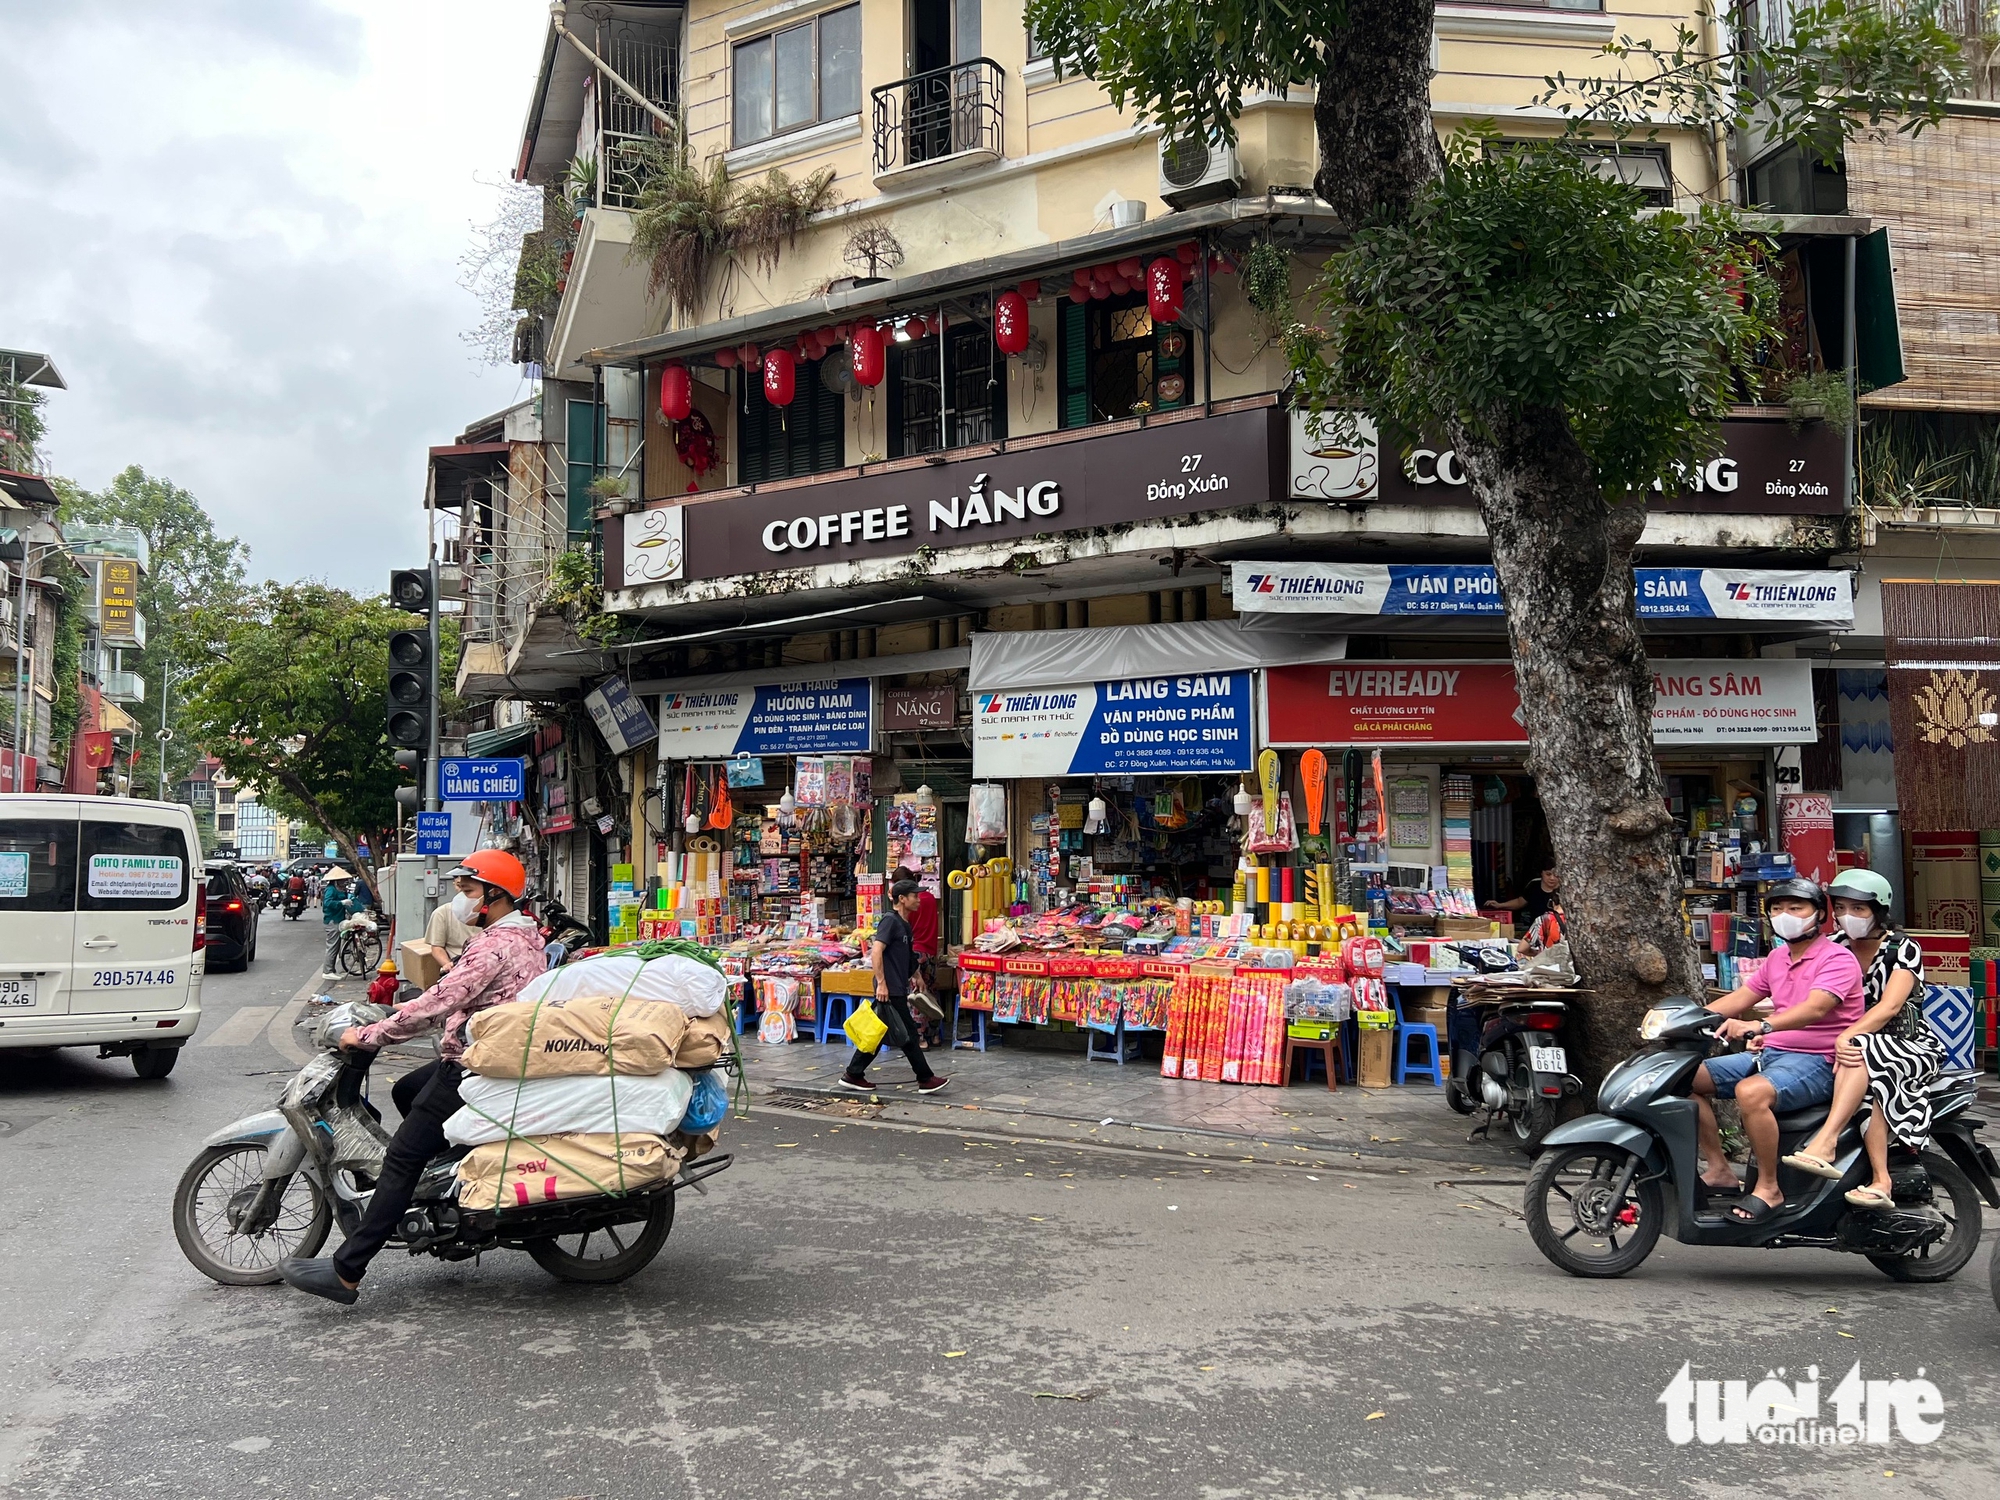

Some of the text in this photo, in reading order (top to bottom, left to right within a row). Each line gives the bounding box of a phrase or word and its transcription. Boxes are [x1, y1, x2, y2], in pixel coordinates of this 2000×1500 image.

[1180, 453, 1203, 473] 27
[1788, 458, 1805, 473] 27
[1146, 473, 1229, 501] Đồng Xuân
[1765, 480, 1829, 498] Đồng Xuân
[762, 473, 1060, 552] COFFEE NẮNG
[1406, 574, 1448, 594] VĂN
[1644, 575, 1688, 598] SÂM
[1430, 602, 1439, 610] 27
[1640, 604, 1690, 613] 0912.936.434
[1176, 673, 1231, 698] SÂM
[1328, 669, 1460, 697] EVEREADY
[1708, 671, 1763, 697] SÂM
[685, 692, 739, 709] THIÊN LONG
[767, 693, 852, 711] HƯƠNG NAM
[895, 696, 942, 717] NẮNG
[1005, 692, 1077, 712] THIÊN LONG
[753, 713, 763, 723] ĐỒ
[764, 713, 785, 723] DÙNG
[786, 714, 801, 723] HỌC
[802, 713, 820, 721] SINH
[848, 709, 867, 719] DÍNH
[981, 715, 999, 725] SỨC
[1032, 714, 1047, 722] TRI
[1049, 711, 1075, 721] THỨC
[1103, 702, 1235, 724] VĂN PHÒNG PHẨM
[1350, 704, 1435, 716] CHẤT LƯỢNG UY TÍN
[1666, 706, 1696, 719] PHẨM
[1720, 706, 1749, 718] DÙNG
[1751, 708, 1772, 720] HỌC
[1773, 708, 1797, 718] SINH
[754, 727, 767, 735] PIN
[768, 725, 783, 734] ĐÈN
[789, 724, 813, 733] TRANH
[832, 722, 847, 731] CÁC
[848, 722, 865, 732] LOẠI
[1354, 721, 1369, 731] GIÁ
[1369, 721, 1380, 731] CẢ
[1382, 720, 1402, 731] PHẢI
[1683, 726, 1693, 734] Hà
[1693, 726, 1704, 735] Nội
[1100, 727, 1239, 745] ĐỒ DÙNG HỌC SINH
[471, 762, 499, 774] PHỐ
[1130, 759, 1148, 769] Đồng
[1170, 759, 1189, 767] Hoàn
[1211, 758, 1222, 766] Hà
[1223, 758, 1236, 767] Nội
[446, 774, 518, 794] HÀNG CHIẾU
[696, 780, 706, 806] YONEX
[422, 815, 449, 826] NÚT BẤM
[418, 828, 449, 838] CHO NGƯỜI
[426, 840, 442, 851] ĐI BỘ
[93, 857, 179, 870] DHTQ FAMILY DELI
[147, 918, 189, 926] TERA-V6
[92, 969, 175, 987] 29D-574.46
[1536, 1060, 1562, 1071] 0614
[516, 1158, 548, 1176] ABS
